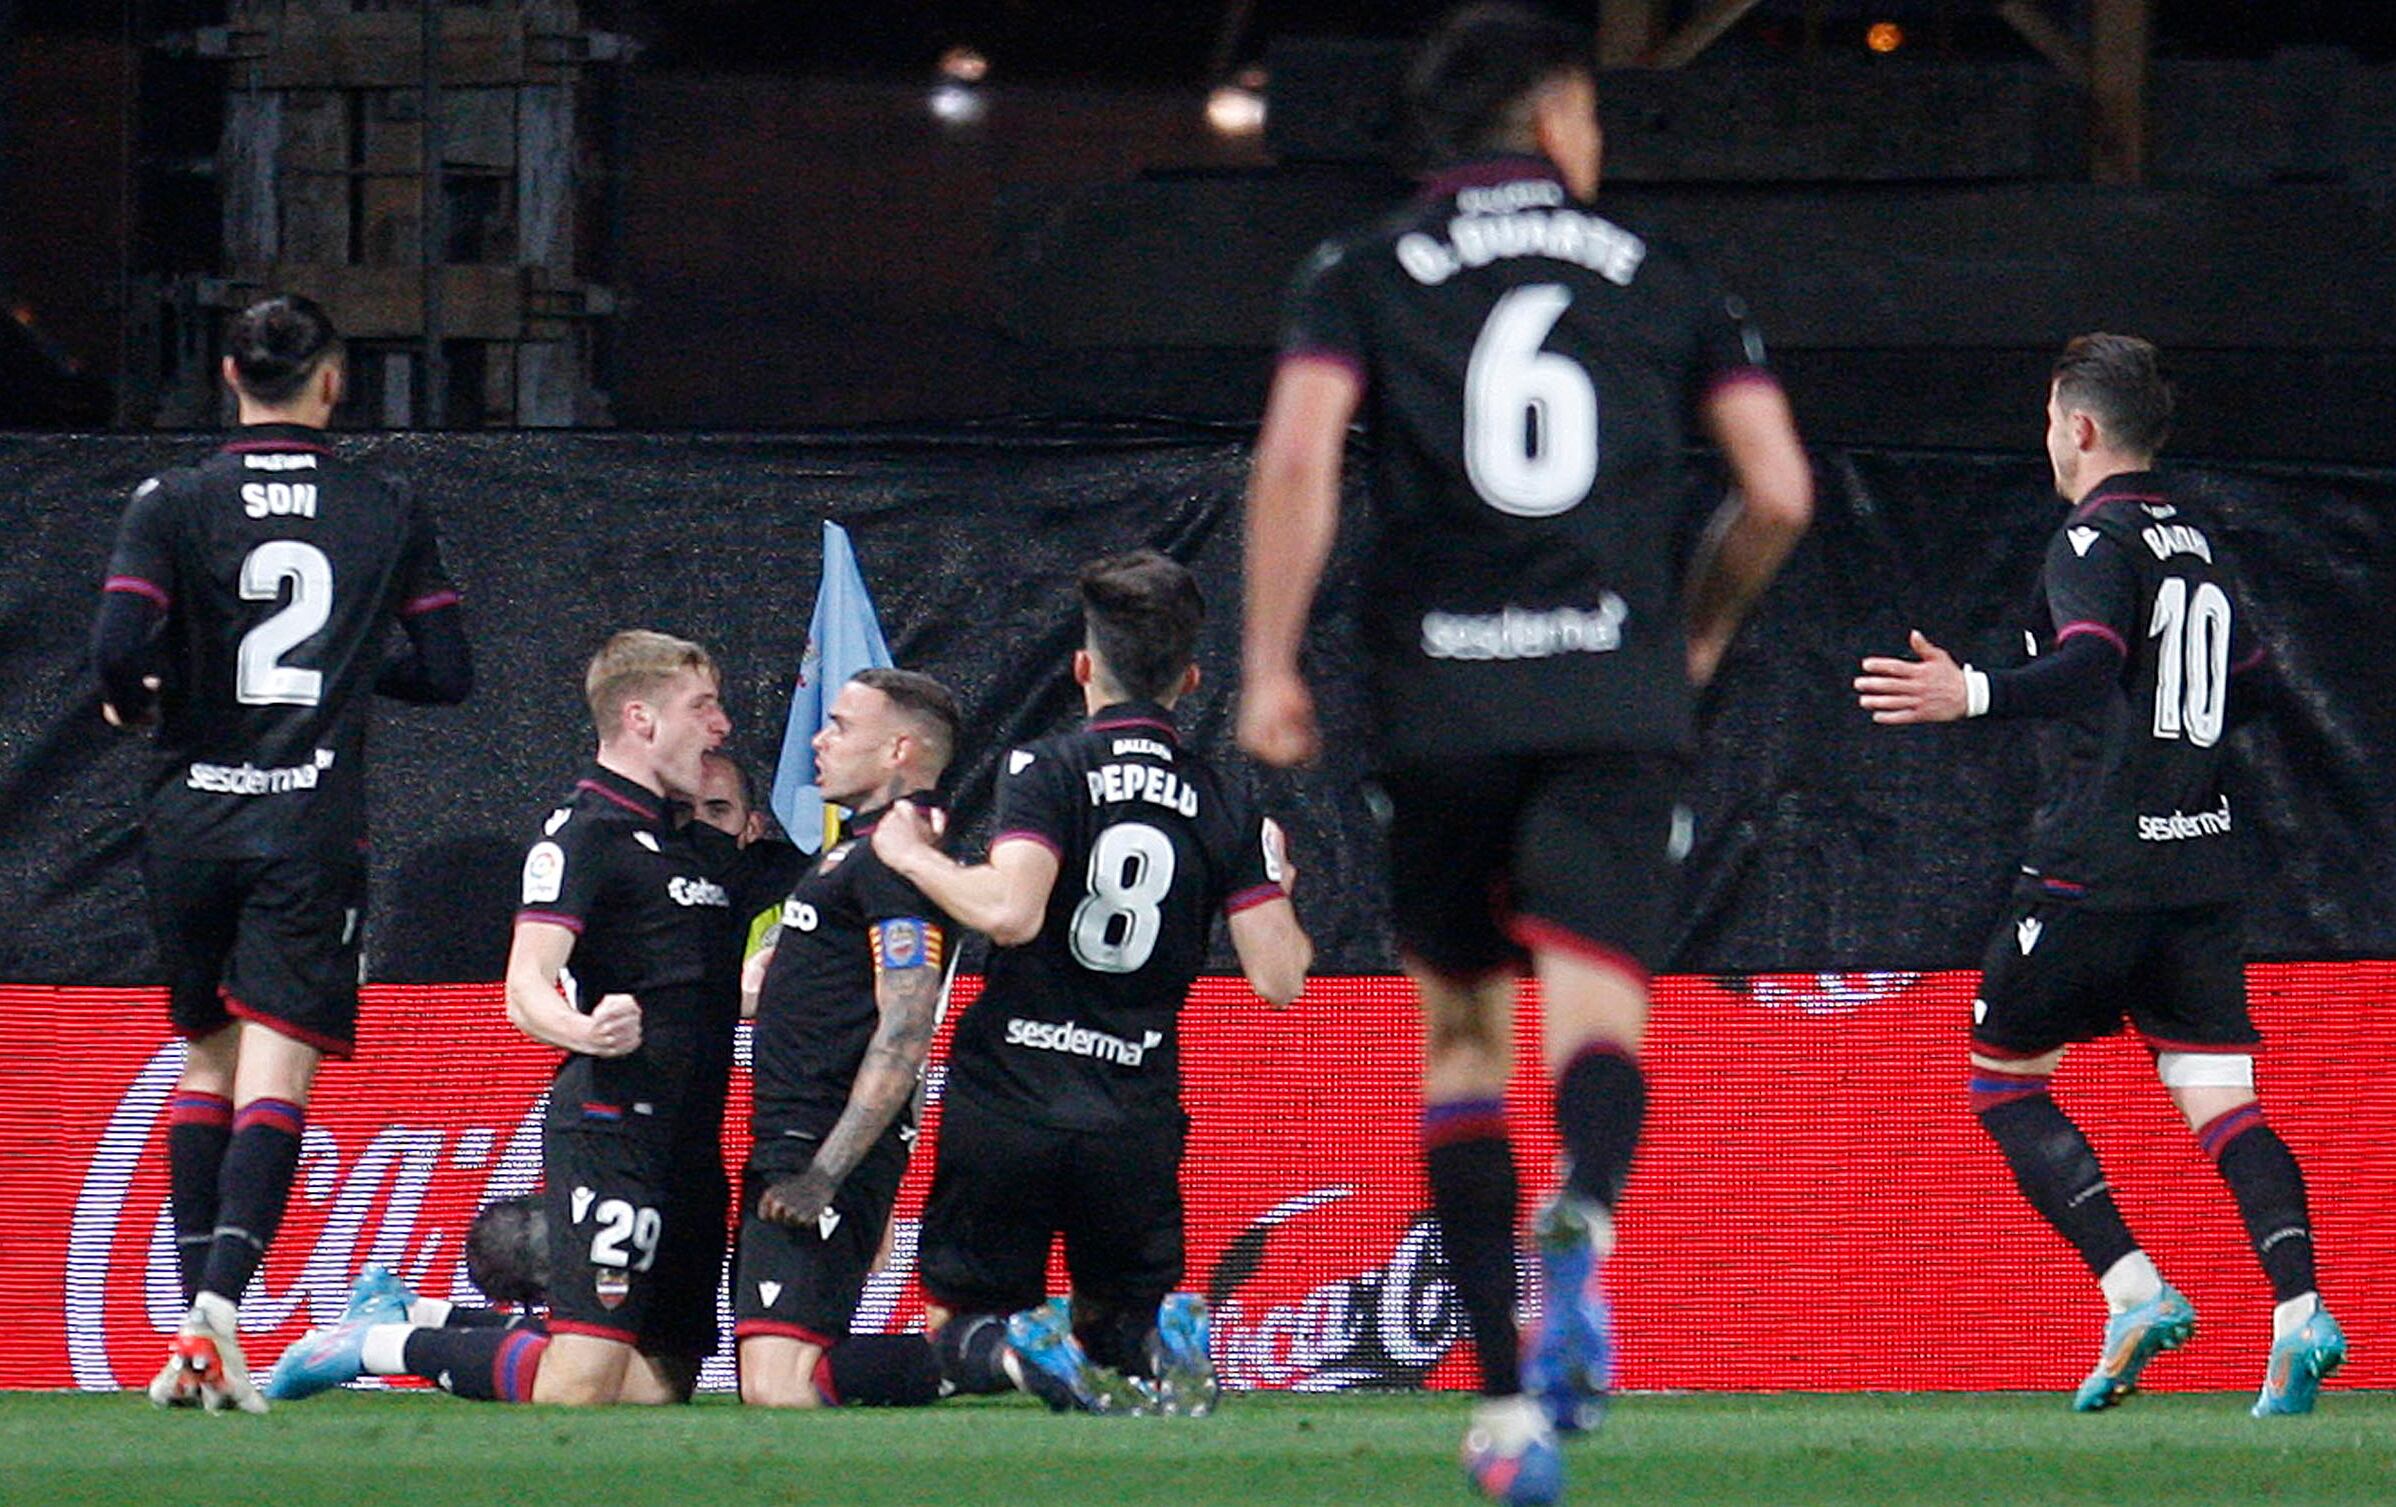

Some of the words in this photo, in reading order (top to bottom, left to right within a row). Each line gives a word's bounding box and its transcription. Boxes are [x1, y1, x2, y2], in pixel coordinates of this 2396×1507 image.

[1463, 283, 1598, 517] 6
[241, 483, 317, 518] SON
[237, 540, 333, 706] 2
[2148, 577, 2231, 748] 10
[1087, 764, 1198, 818] PEPELU
[1069, 822, 1176, 973] 8
[1005, 1019, 1144, 1066] sesderma
[590, 1200, 662, 1272] 29
